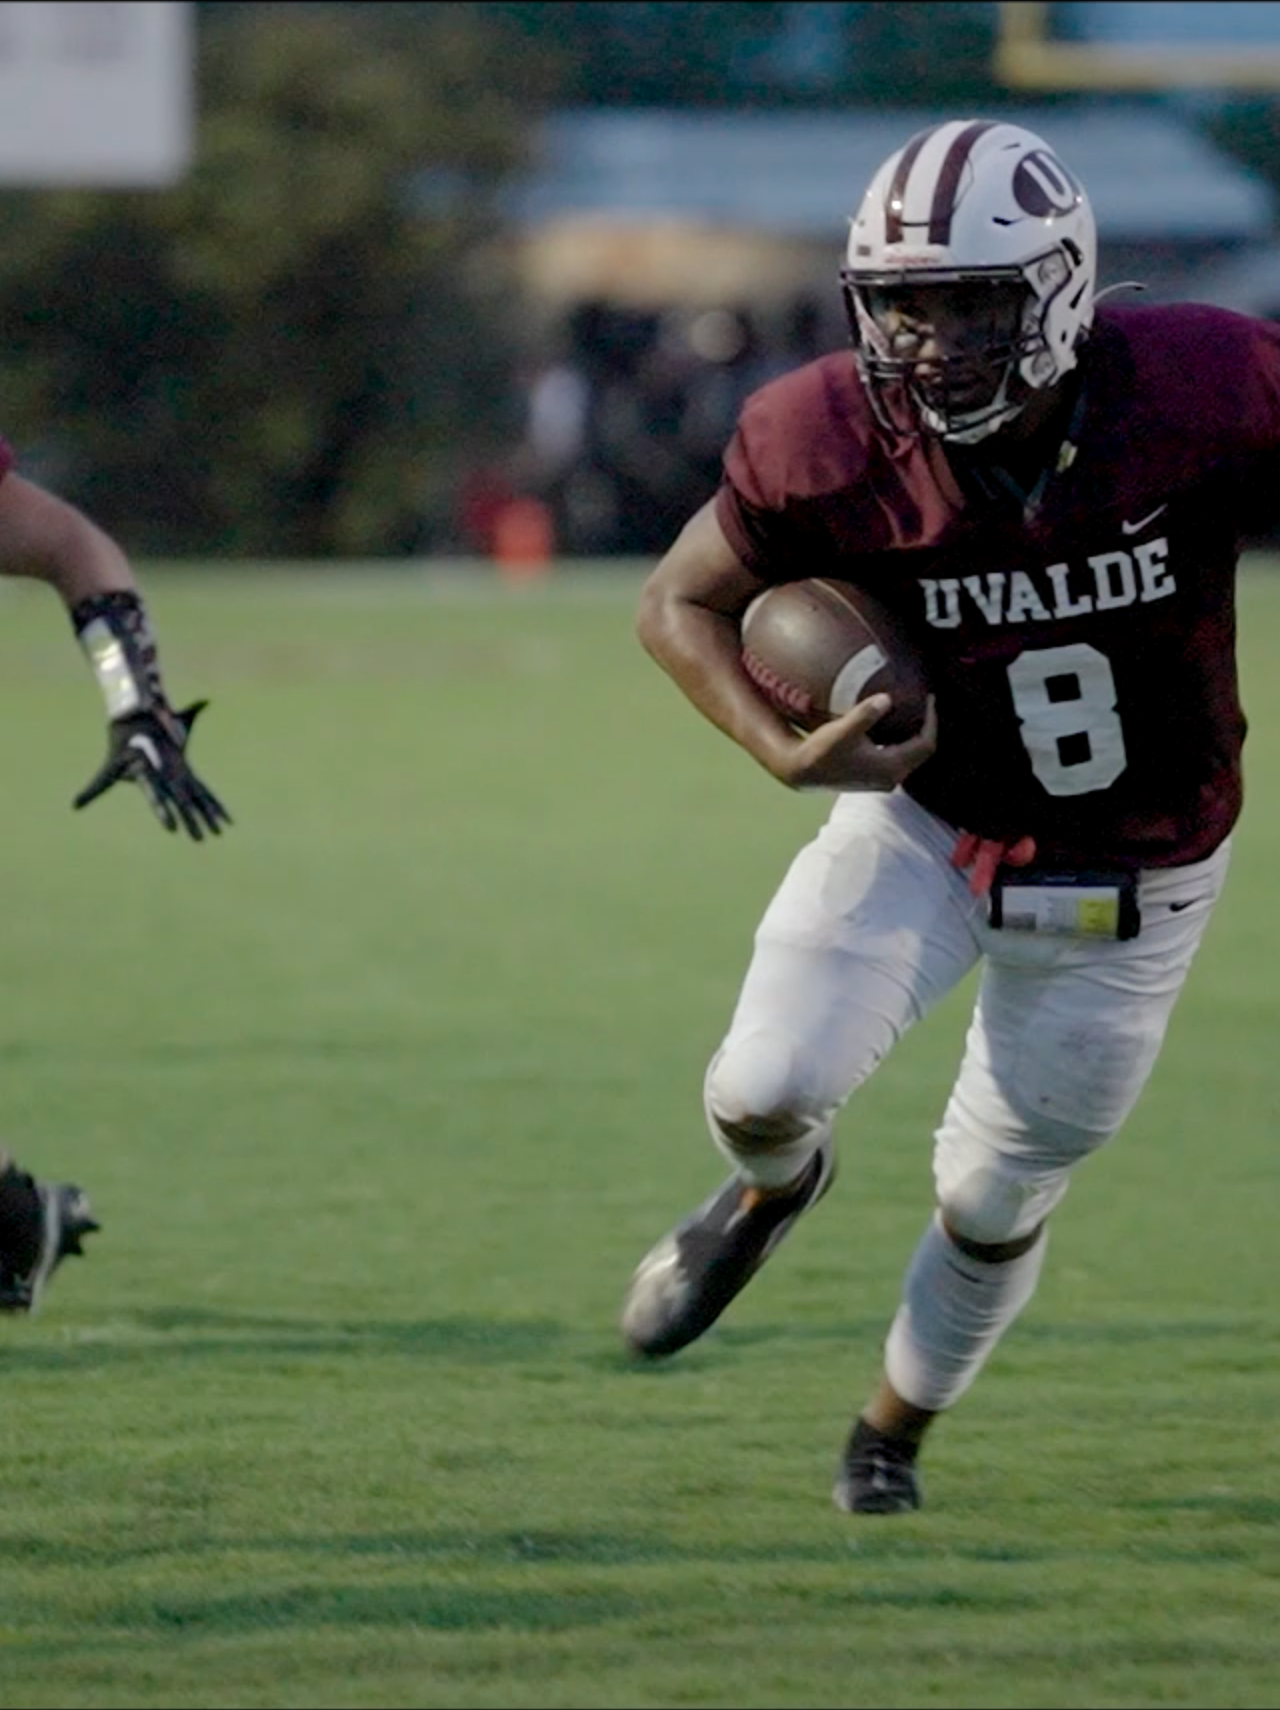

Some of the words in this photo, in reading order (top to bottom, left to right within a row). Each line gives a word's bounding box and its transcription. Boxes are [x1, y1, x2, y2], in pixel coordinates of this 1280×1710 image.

[1021, 151, 1074, 210] U
[918, 538, 1176, 629] UVALDE
[1006, 642, 1128, 798] 8
